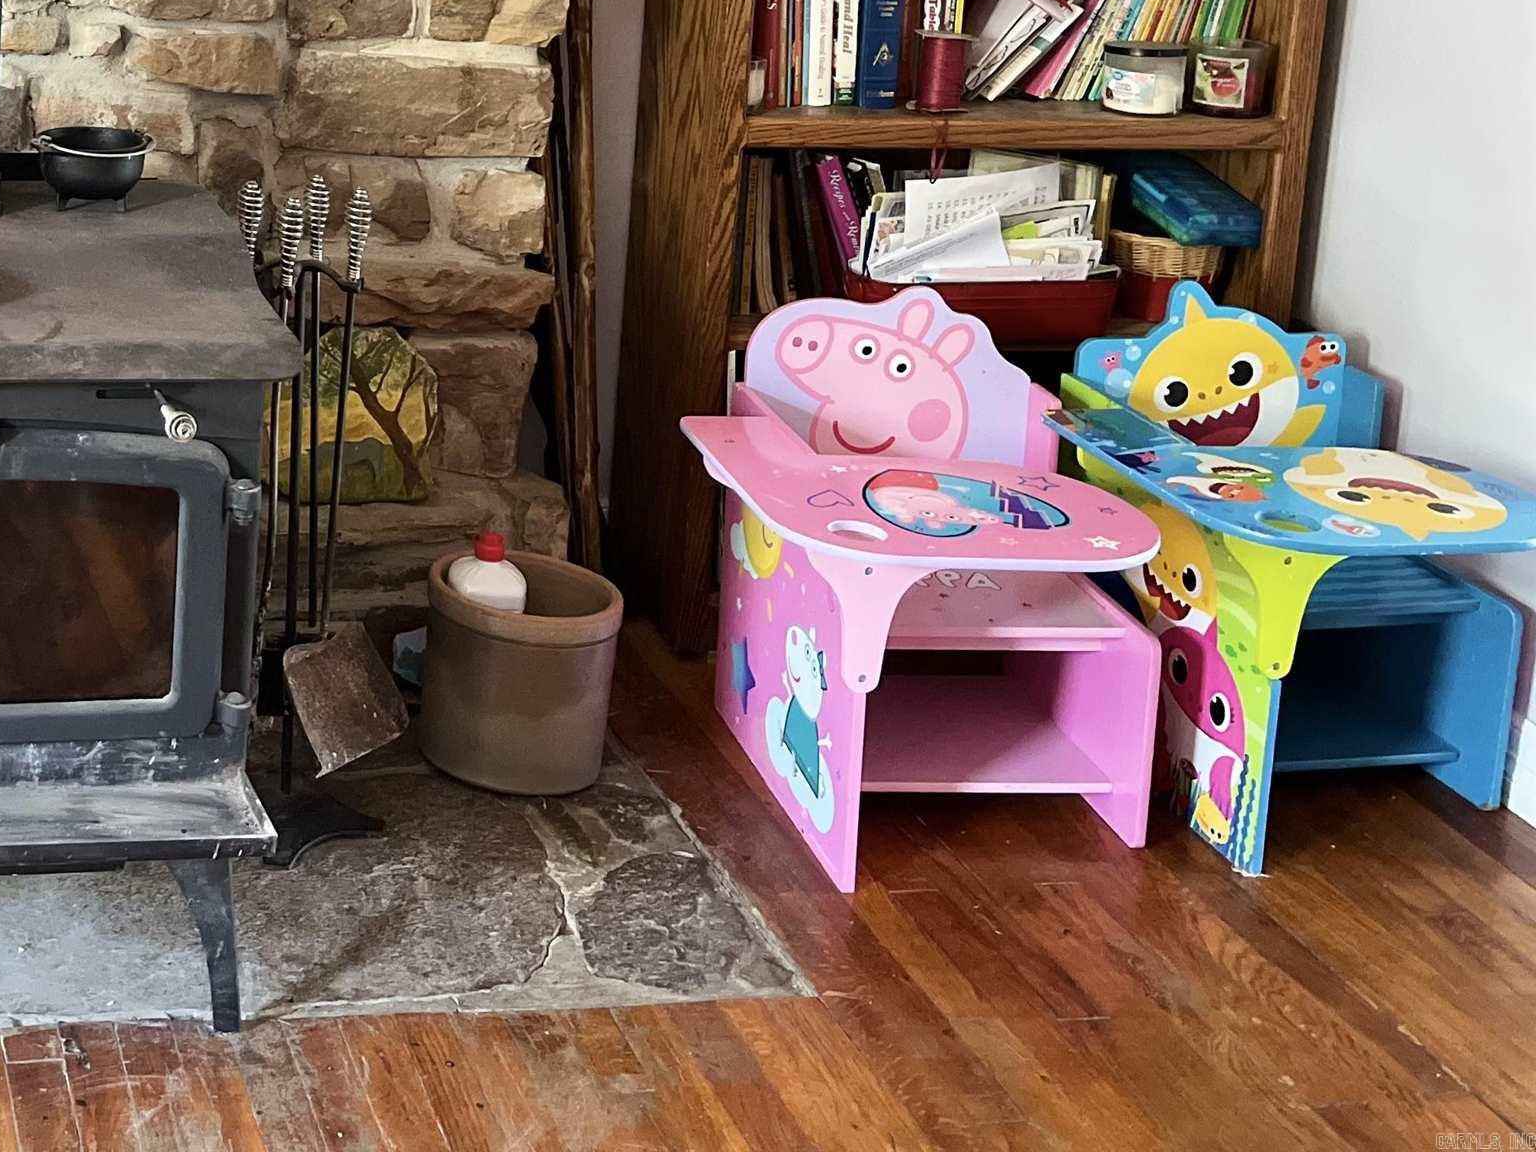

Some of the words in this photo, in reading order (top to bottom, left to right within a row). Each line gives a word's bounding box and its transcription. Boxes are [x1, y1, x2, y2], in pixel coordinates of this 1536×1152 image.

[843, 0, 854, 22] and
[842, 24, 853, 54] Heal
[830, 169, 846, 209] Recipes
